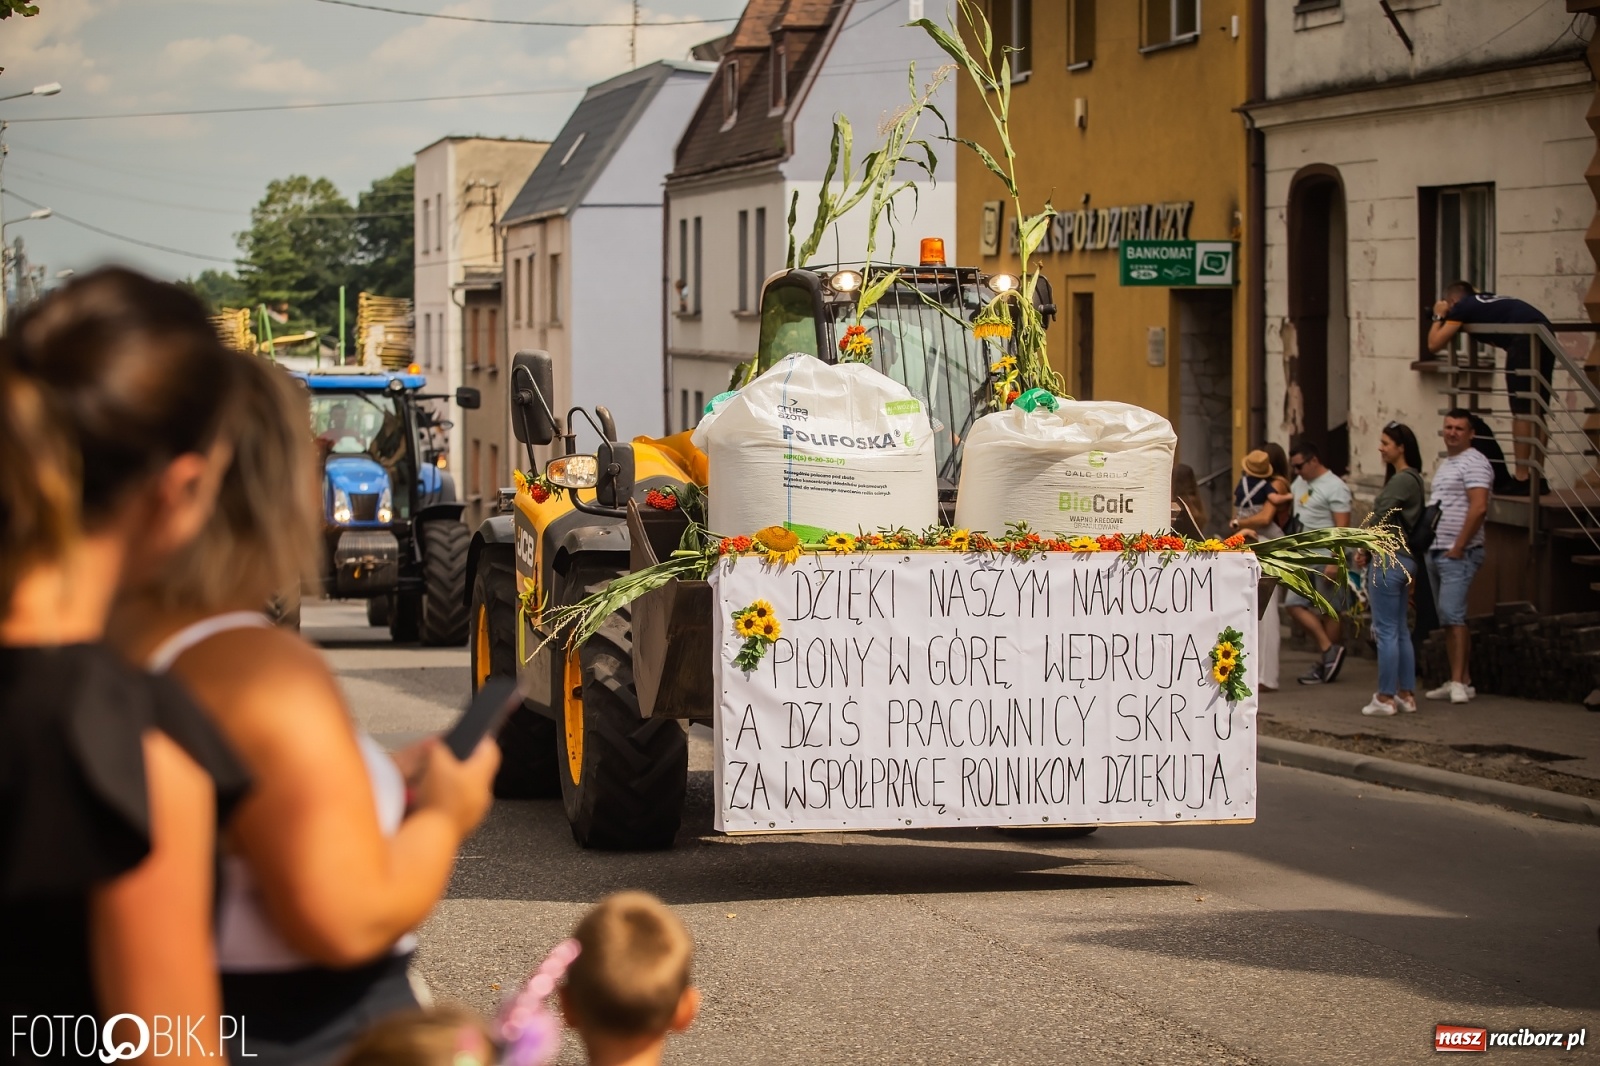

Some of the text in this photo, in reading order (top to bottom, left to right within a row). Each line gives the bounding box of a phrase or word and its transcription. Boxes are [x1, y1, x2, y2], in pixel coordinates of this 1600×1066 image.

[1126, 246, 1194, 260] BANKOMAT
[1059, 492, 1134, 514] BioCalc
[517, 525, 535, 568] JCB
[787, 566, 1214, 626] DZIĘKI NASZYM NAWOZOM
[772, 628, 1207, 689] PLONY W GÓRĘ WĘDRUJĄ
[735, 693, 1232, 751] A DZIŚ PRACOWNICY SKR-U
[728, 753, 1232, 815] ZA WSPÓŁPRACĘ ROLNIKOM DZIĘKUJĄ
